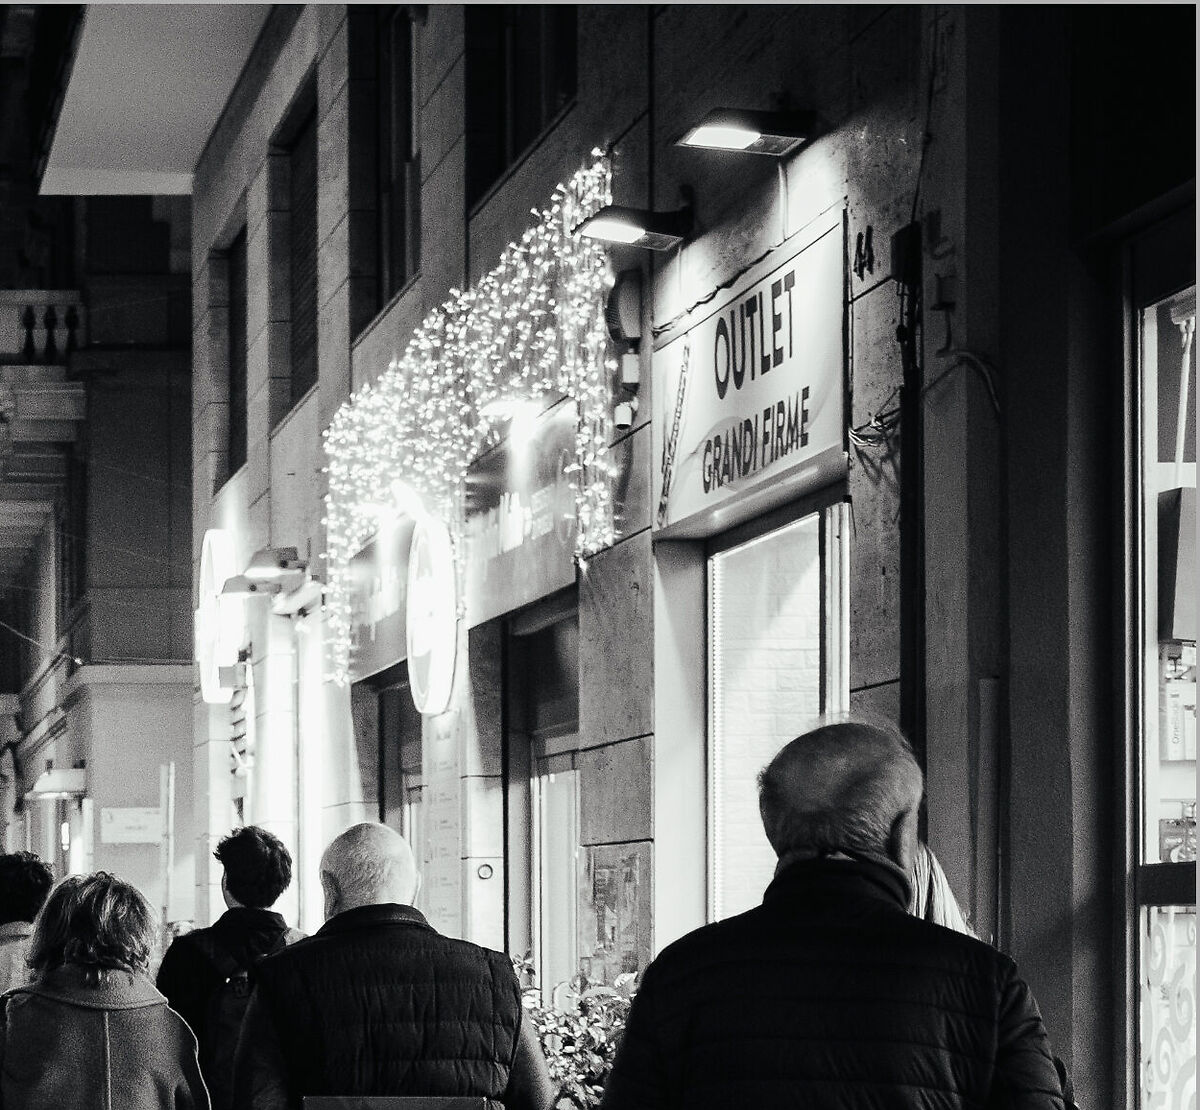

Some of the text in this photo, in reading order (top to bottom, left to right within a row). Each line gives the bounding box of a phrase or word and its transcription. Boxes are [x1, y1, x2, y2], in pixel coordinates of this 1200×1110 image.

[715, 270, 796, 400] OUTLET
[703, 386, 811, 493] GRANDI FIRME
